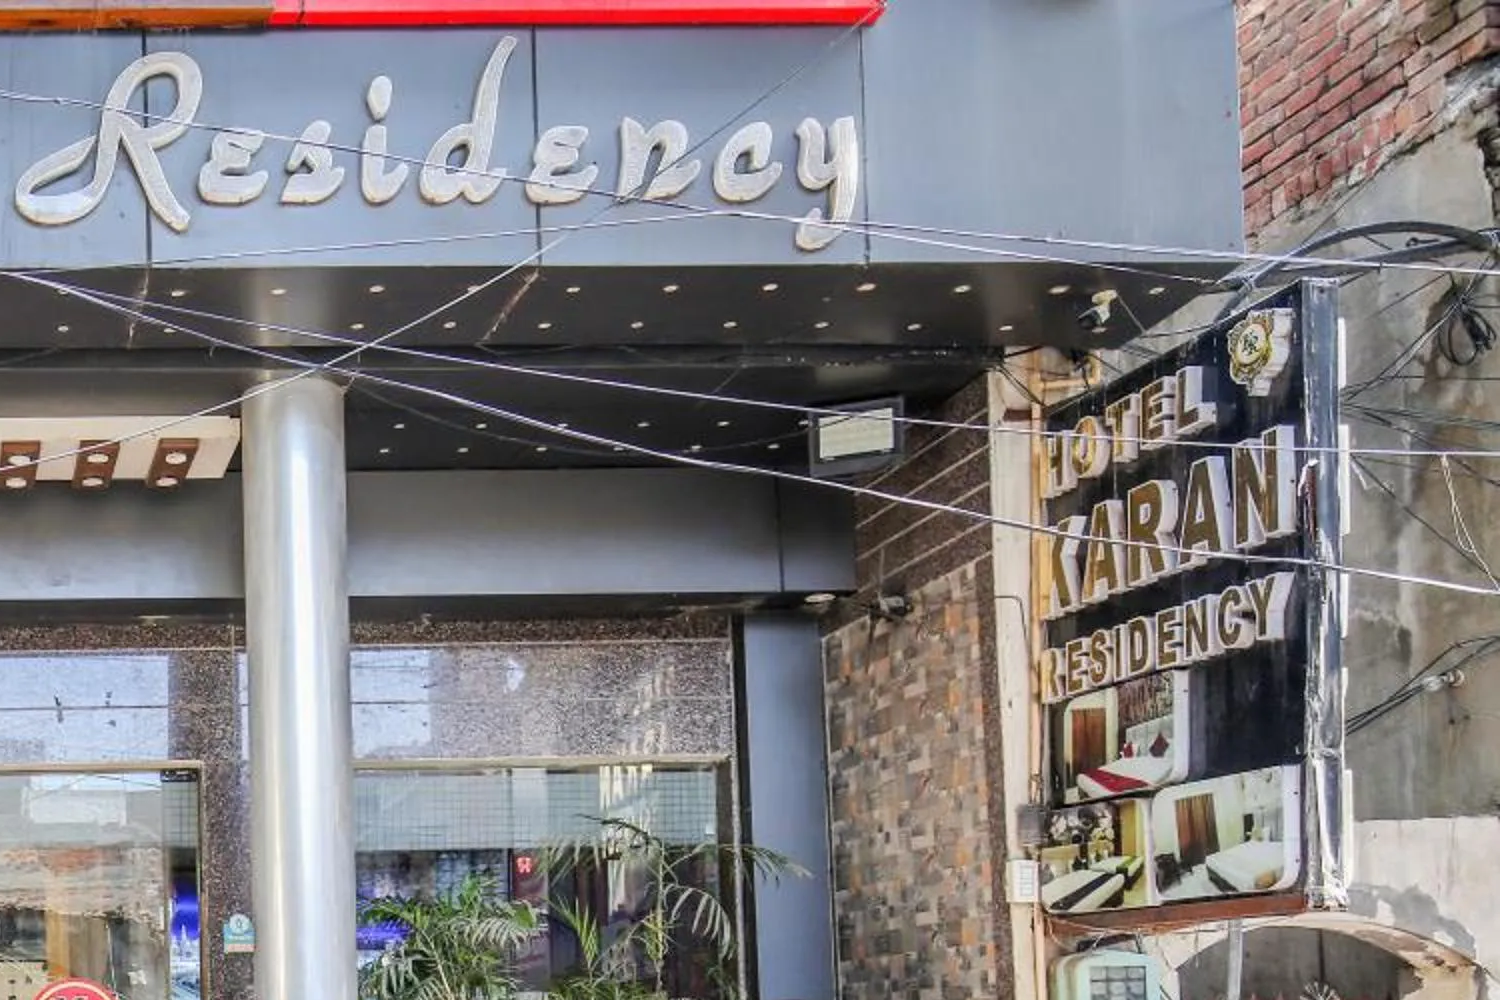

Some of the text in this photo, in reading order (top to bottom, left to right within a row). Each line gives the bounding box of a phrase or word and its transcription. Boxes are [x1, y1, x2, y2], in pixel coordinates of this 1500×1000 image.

[15, 35, 858, 252] Residency
[1041, 366, 1217, 498] HOTEL
[1040, 425, 1297, 620] KARAN
[1039, 572, 1296, 703] RESIDENCY
